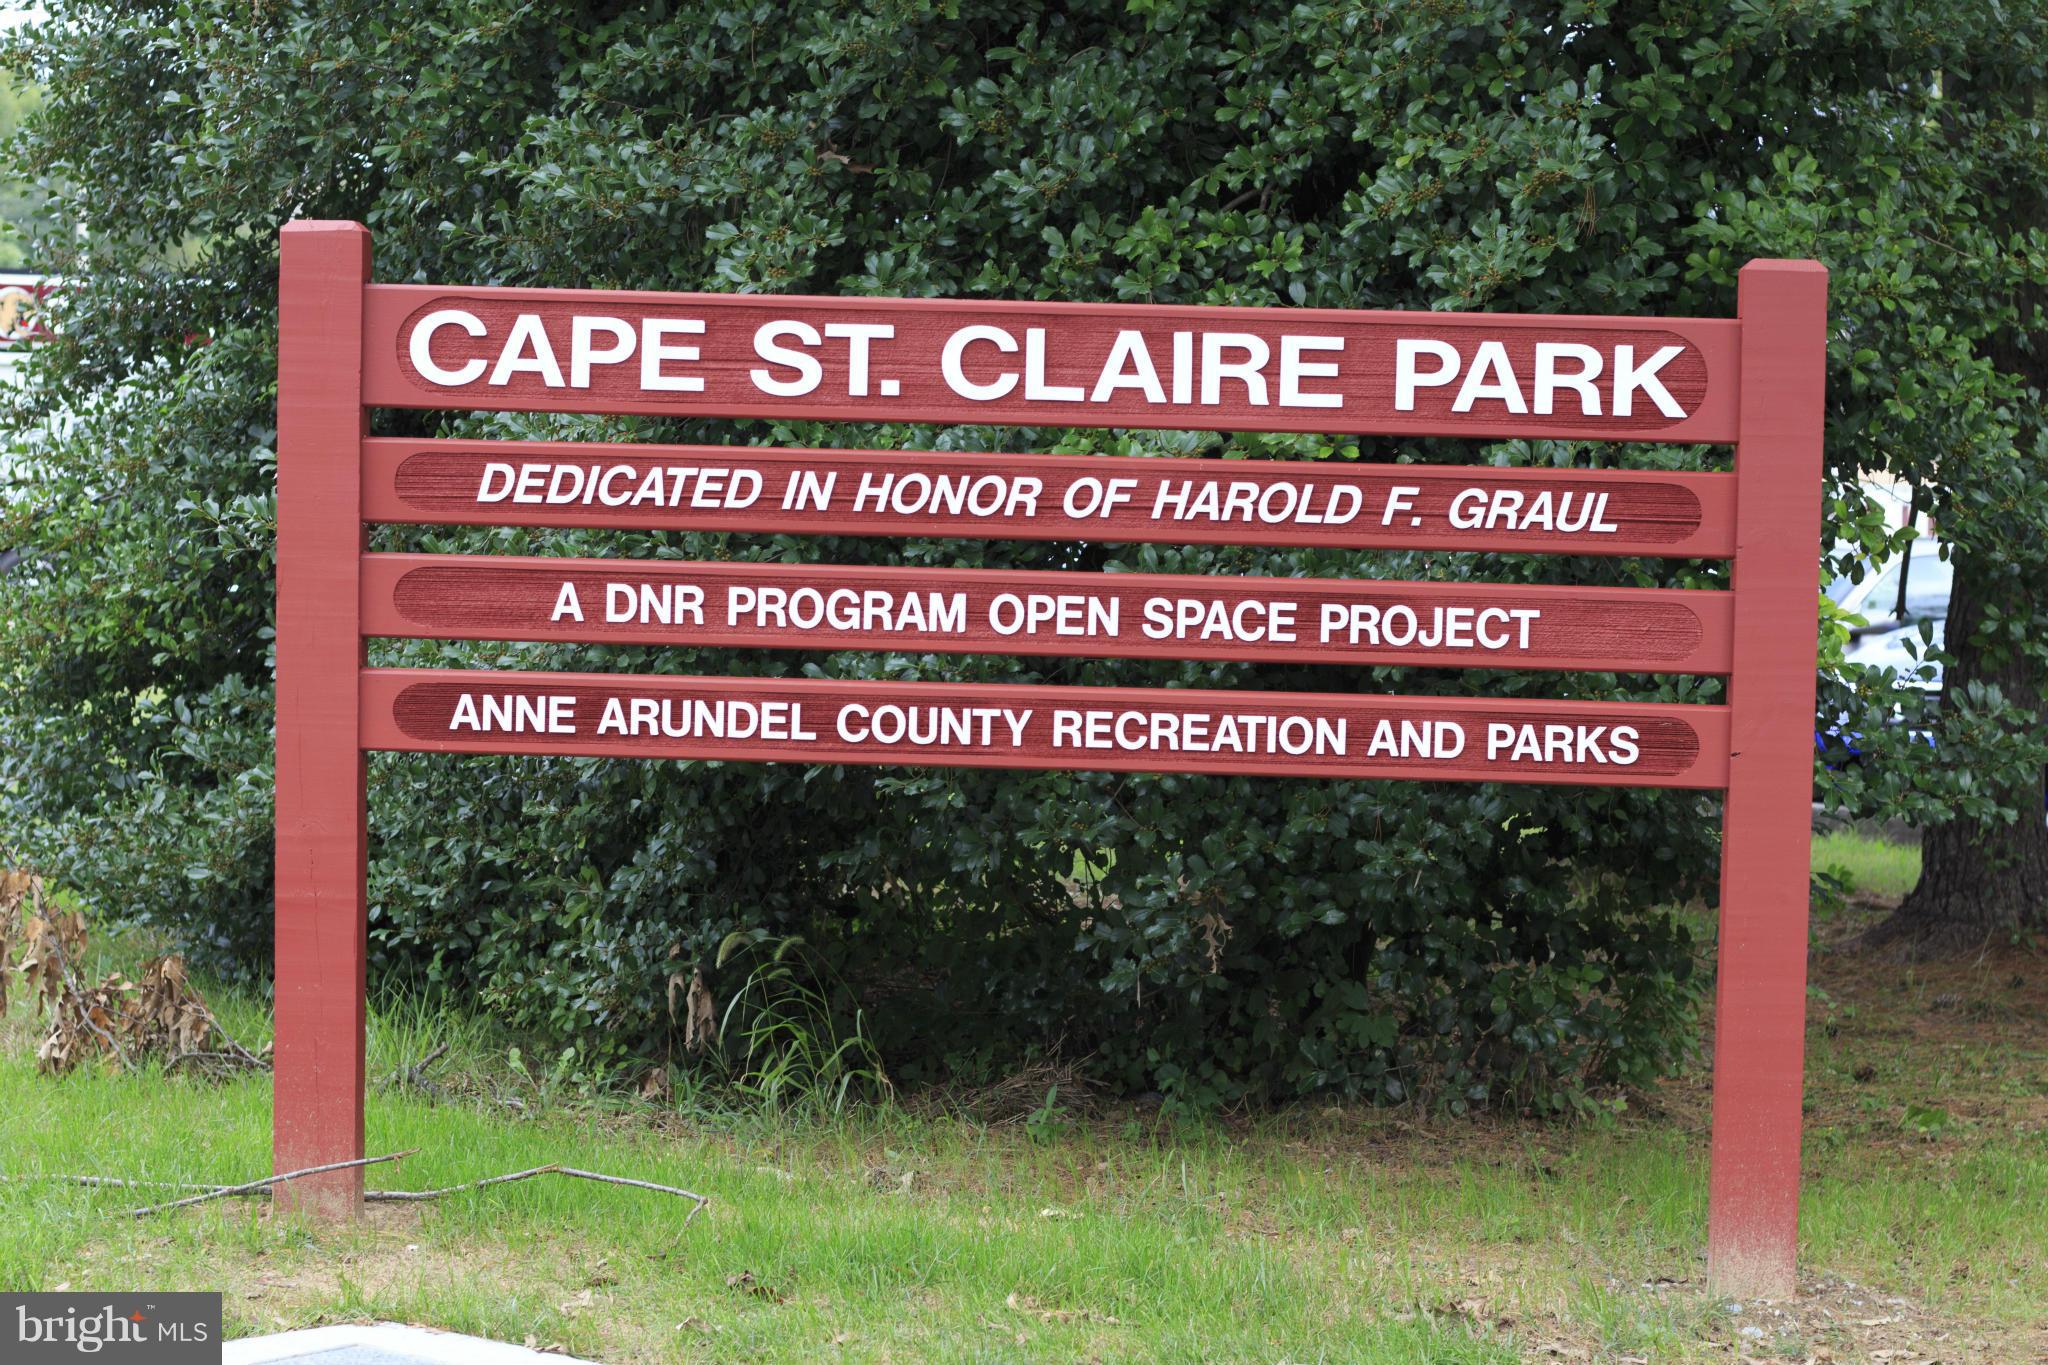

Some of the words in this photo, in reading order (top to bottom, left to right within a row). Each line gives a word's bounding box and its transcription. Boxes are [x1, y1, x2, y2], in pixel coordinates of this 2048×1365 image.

[410, 310, 705, 391] CAPE
[750, 320, 900, 397] ST.
[941, 325, 1344, 407] CLAIRE
[1395, 339, 1687, 418] PARK
[477, 463, 763, 508] DEDICATED
[782, 471, 837, 510] IN
[853, 472, 1043, 517] HONOR
[1063, 477, 1138, 519] OF
[1152, 480, 1362, 524] HAROLD
[1382, 487, 1421, 527] F.
[1449, 488, 1617, 532] GRAUL
[551, 582, 584, 621] A
[606, 583, 704, 624] DNR
[728, 586, 966, 633] PROGRAM
[989, 593, 1119, 637] OPEN
[1142, 597, 1297, 641] SPACE
[1320, 604, 1540, 649] PROJECT
[449, 694, 576, 733] ANNE
[597, 698, 816, 741] ARUNDEL
[837, 704, 1032, 748] COUNTY
[1053, 710, 1346, 755] RECREATION
[1367, 720, 1465, 758] AND
[1488, 723, 1639, 764] PARKS
